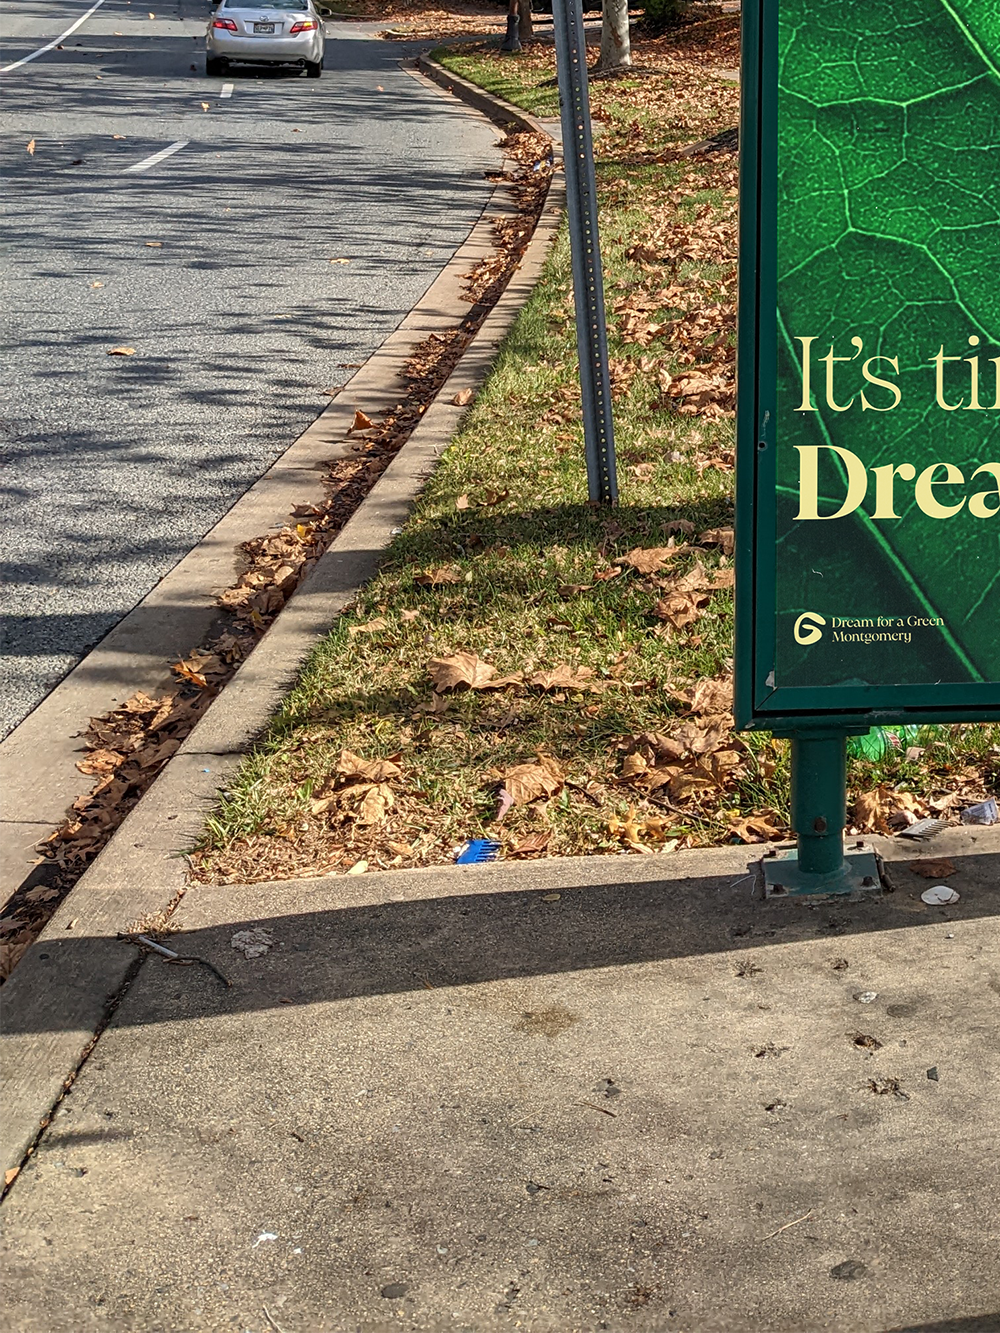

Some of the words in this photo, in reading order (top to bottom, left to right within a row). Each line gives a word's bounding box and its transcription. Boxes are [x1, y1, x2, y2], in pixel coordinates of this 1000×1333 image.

[831, 617, 874, 628] Dream
[877, 616, 894, 627] for
[896, 619, 904, 627] a
[906, 615, 945, 627] Green
[831, 631, 912, 645] Montgomery
